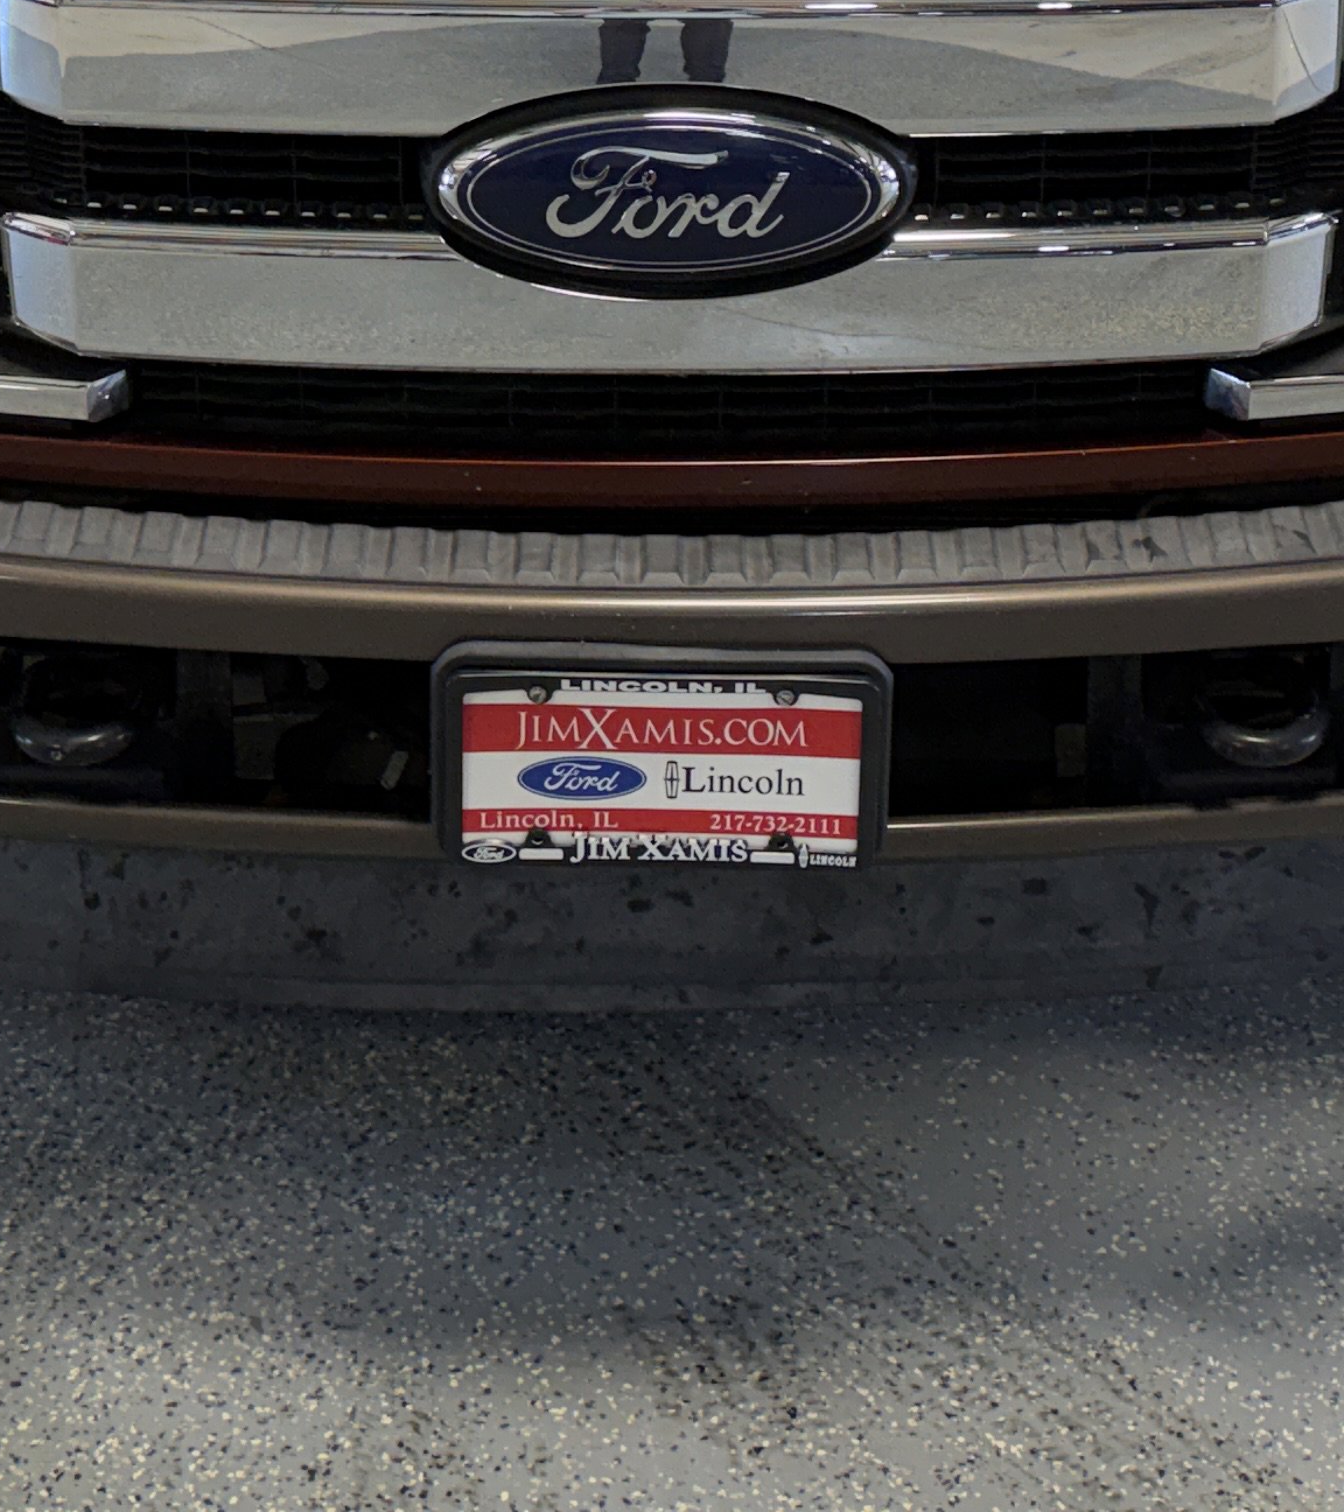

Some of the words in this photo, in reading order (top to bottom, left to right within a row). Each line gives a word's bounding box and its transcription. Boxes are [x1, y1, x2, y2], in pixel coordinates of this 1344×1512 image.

[545, 145, 791, 239] Ford
[560, 679, 723, 694] LINCOLN,
[734, 681, 766, 694] IL
[544, 761, 619, 792] Ford
[682, 766, 805, 796] Lincoln
[480, 811, 583, 829] Lincoln,
[593, 811, 619, 828] IL
[710, 814, 841, 835] 217-732-2111
[569, 831, 631, 863] JIM
[637, 834, 748, 863] XAMIS
